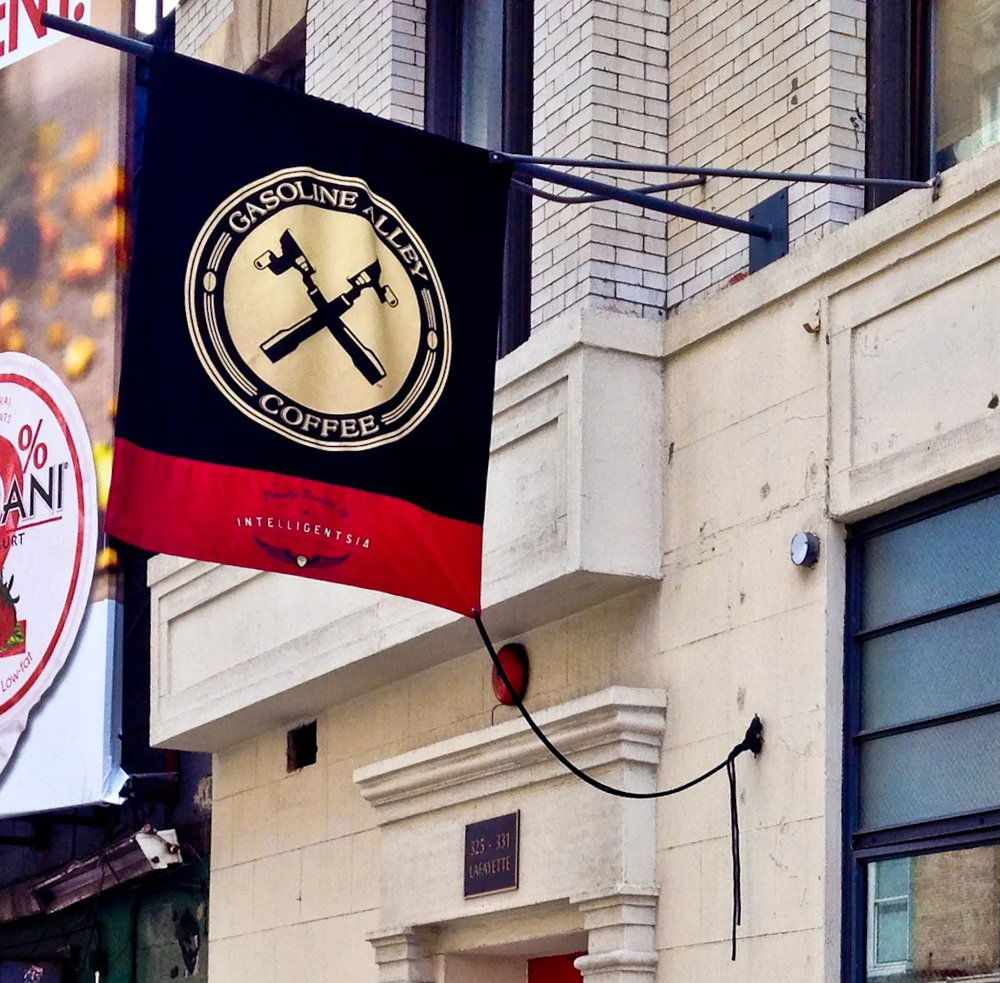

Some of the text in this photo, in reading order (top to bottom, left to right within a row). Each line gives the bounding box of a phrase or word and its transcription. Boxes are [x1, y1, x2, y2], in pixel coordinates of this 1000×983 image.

[228, 181, 429, 281] GASOLINE ALLEY
[258, 393, 380, 438] COFFEE
[0, 462, 63, 525] ANI
[237, 516, 370, 549] INTELLIGENTSIA
[469, 856, 511, 879] LAFAYETTE
